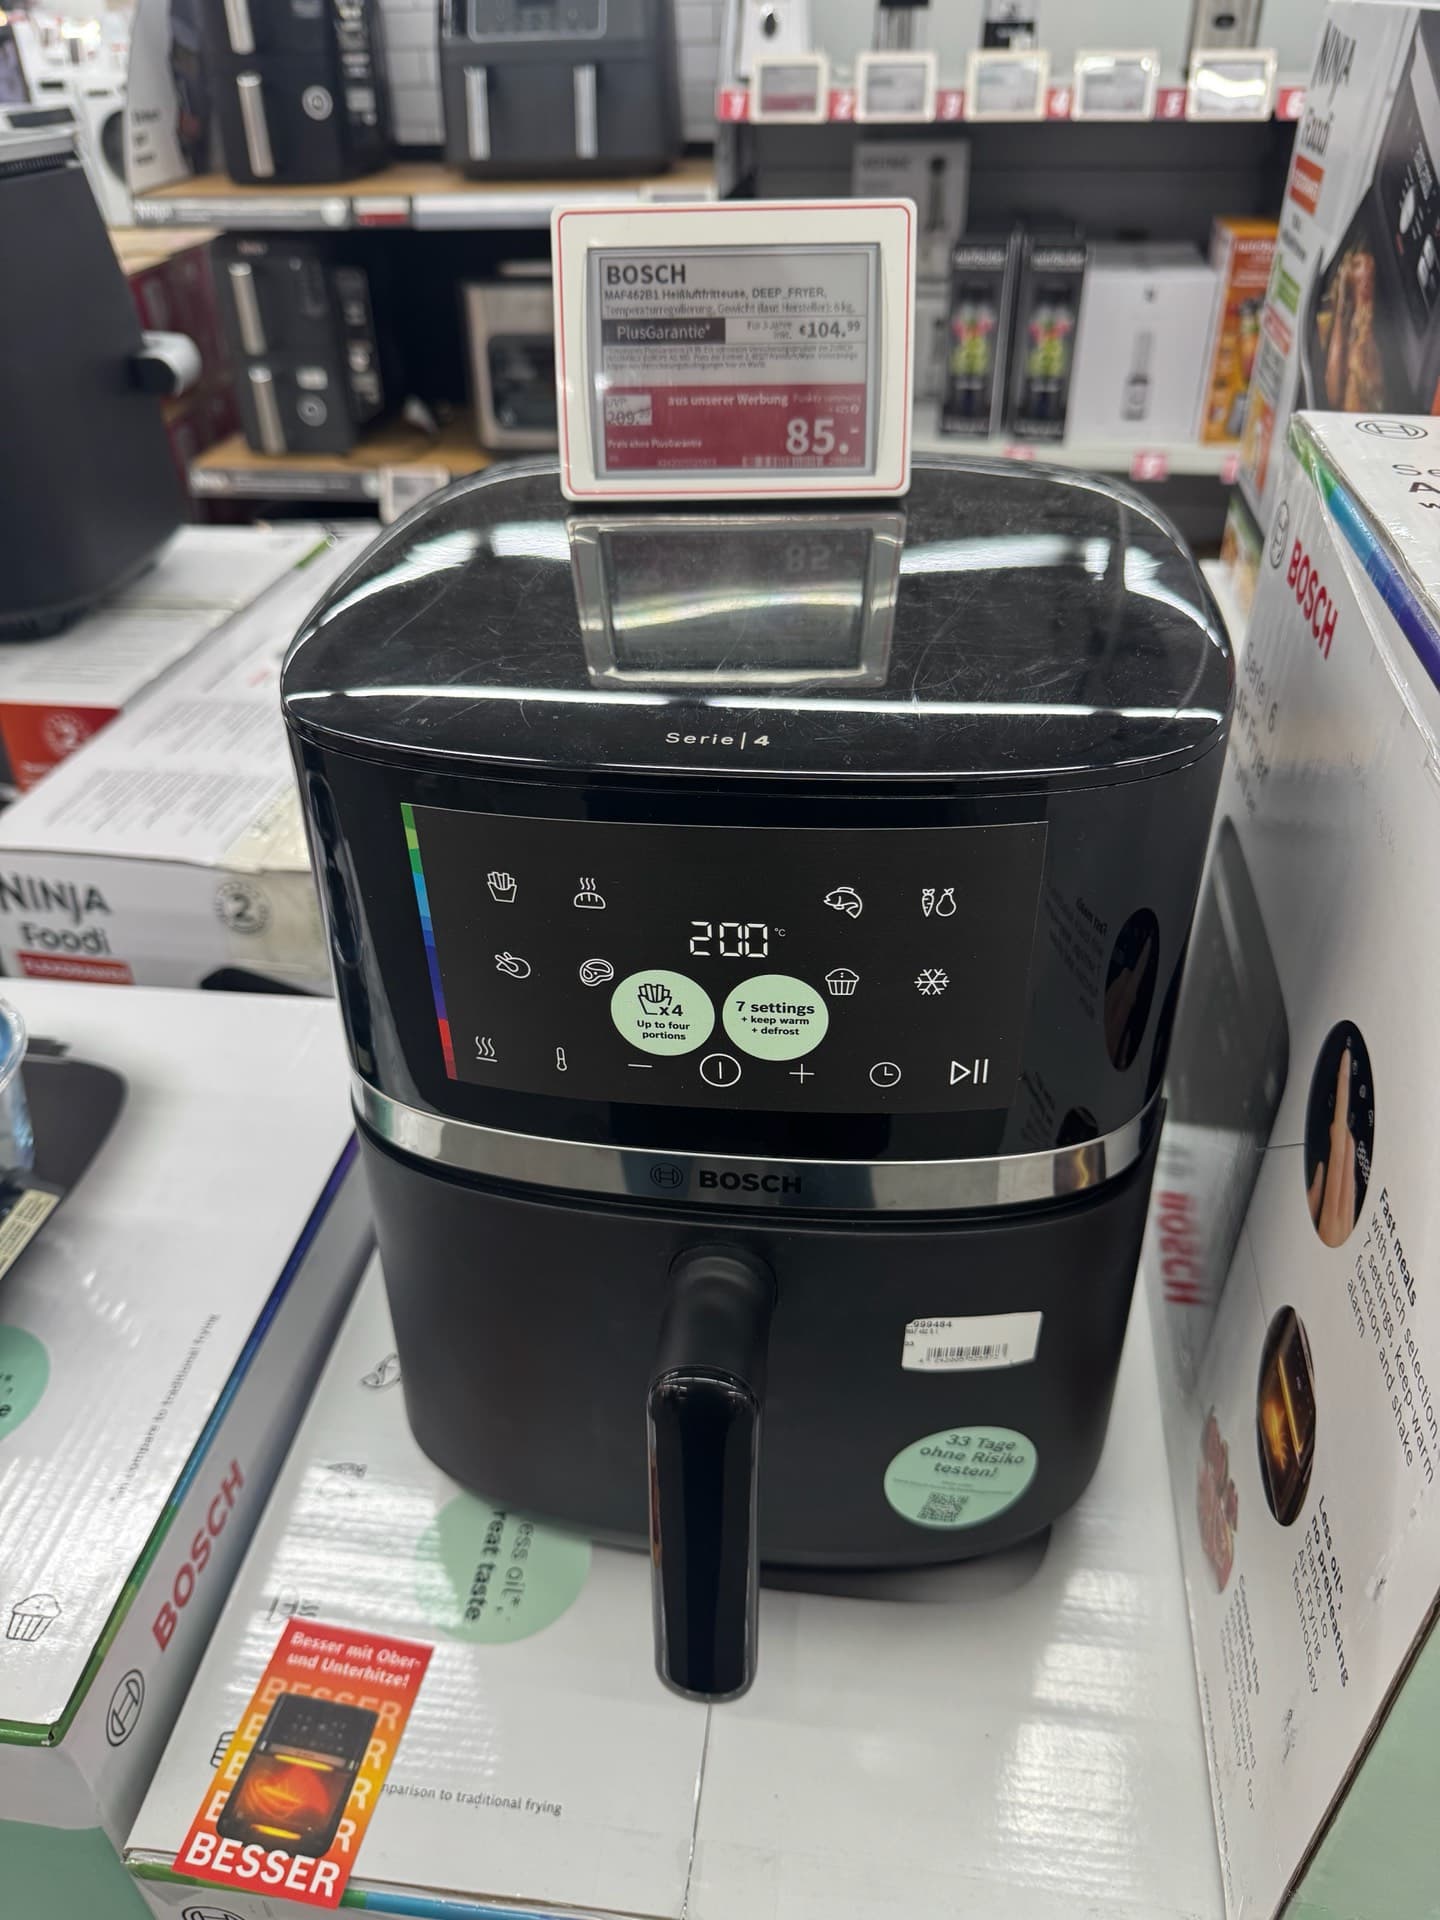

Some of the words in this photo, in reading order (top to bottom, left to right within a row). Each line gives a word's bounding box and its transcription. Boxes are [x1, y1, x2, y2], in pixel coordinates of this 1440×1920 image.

[607, 263, 686, 285] BOSCH
[736, 391, 789, 409] Werbung
[1286, 536, 1338, 661] BOSCH
[0, 872, 113, 925] NINJA
[20, 921, 113, 956] Foodi
[689, 921, 768, 958] 200
[636, 1019, 652, 1031] Up
[655, 1020, 666, 1030] to
[668, 1021, 691, 1031] four
[659, 1003, 683, 1017] x4
[736, 1001, 746, 1012] 7
[750, 1001, 815, 1016] settings
[750, 1015, 777, 1026] keep
[779, 1017, 810, 1026] warm
[642, 1030, 686, 1041] portions
[760, 1026, 800, 1036] defrost
[700, 1170, 802, 1194] BOSCH
[1380, 1186, 1396, 1239] Fast
[1394, 1238, 1417, 1308] meals
[1346, 1279, 1366, 1339] alarm
[1371, 1211, 1388, 1261] with
[1385, 1259, 1406, 1326] touch
[1404, 1327, 1438, 1450] selection,
[1355, 1253, 1381, 1345] function
[1378, 1347, 1396, 1393] and
[1391, 1394, 1414, 1467] shake
[1367, 1253, 1394, 1348] settings,
[1394, 1344, 1434, 1485] keep-warm
[919, 1445, 967, 1462] ohne
[971, 1451, 1025, 1465] Risiko
[945, 1433, 971, 1447] 33
[977, 1437, 1017, 1452] Tage
[934, 1461, 999, 1478] testen!
[1319, 1495, 1333, 1551] Less
[153, 1460, 244, 1653] BOSCH
[464, 1562, 496, 1622] taste
[1305, 1529, 1322, 1608] thanks
[1320, 1611, 1328, 1638] to
[1312, 1514, 1321, 1545] no
[1318, 1549, 1349, 1688] preheating
[290, 1630, 346, 1655] Besser
[346, 1643, 375, 1663] mit
[376, 1648, 422, 1670] Ober-
[286, 1652, 320, 1671] und
[321, 1656, 411, 1689] Unterhitze!
[440, 1788, 453, 1801] to
[456, 1791, 522, 1810] traditional
[525, 1797, 562, 1817] frying
[184, 1831, 341, 1899] BESSER
